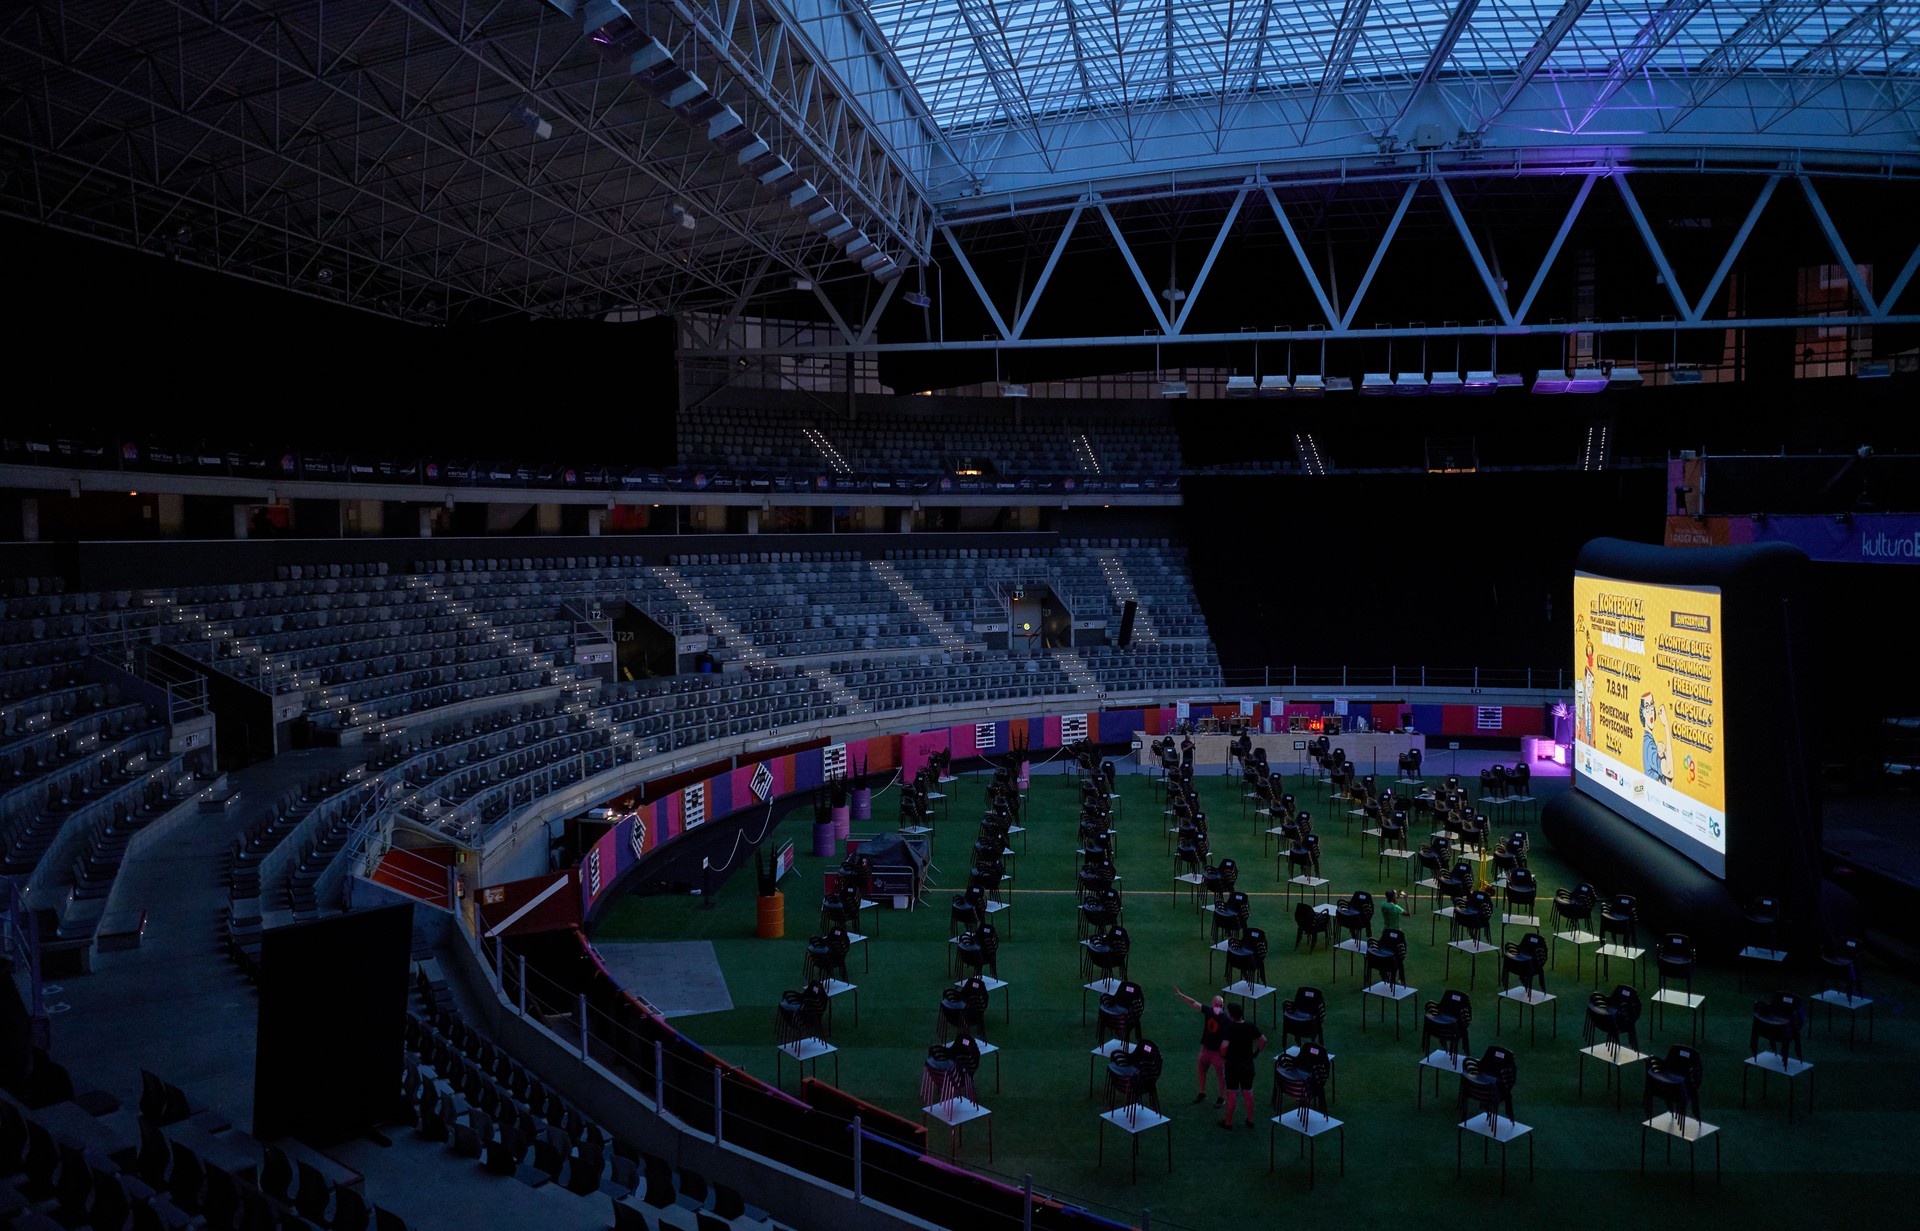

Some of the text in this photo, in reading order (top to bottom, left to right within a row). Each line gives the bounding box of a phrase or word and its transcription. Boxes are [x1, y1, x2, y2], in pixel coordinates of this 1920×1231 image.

[1599, 593, 1645, 620] KORTERRAZA
[1619, 617, 1645, 641] GASTEIZ
[1664, 635, 1690, 656] CONTRA
[1690, 640, 1712, 662] BLUES
[1656, 653, 1675, 673] WILLIS
[1675, 658, 1712, 681] DRUMMOND
[1672, 677, 1712, 705] FREEDONIA
[1674, 700, 1707, 726] CAPSULA
[1600, 715, 1633, 739] PROYECCIONES
[1672, 721, 1713, 753] CORIZONAS
